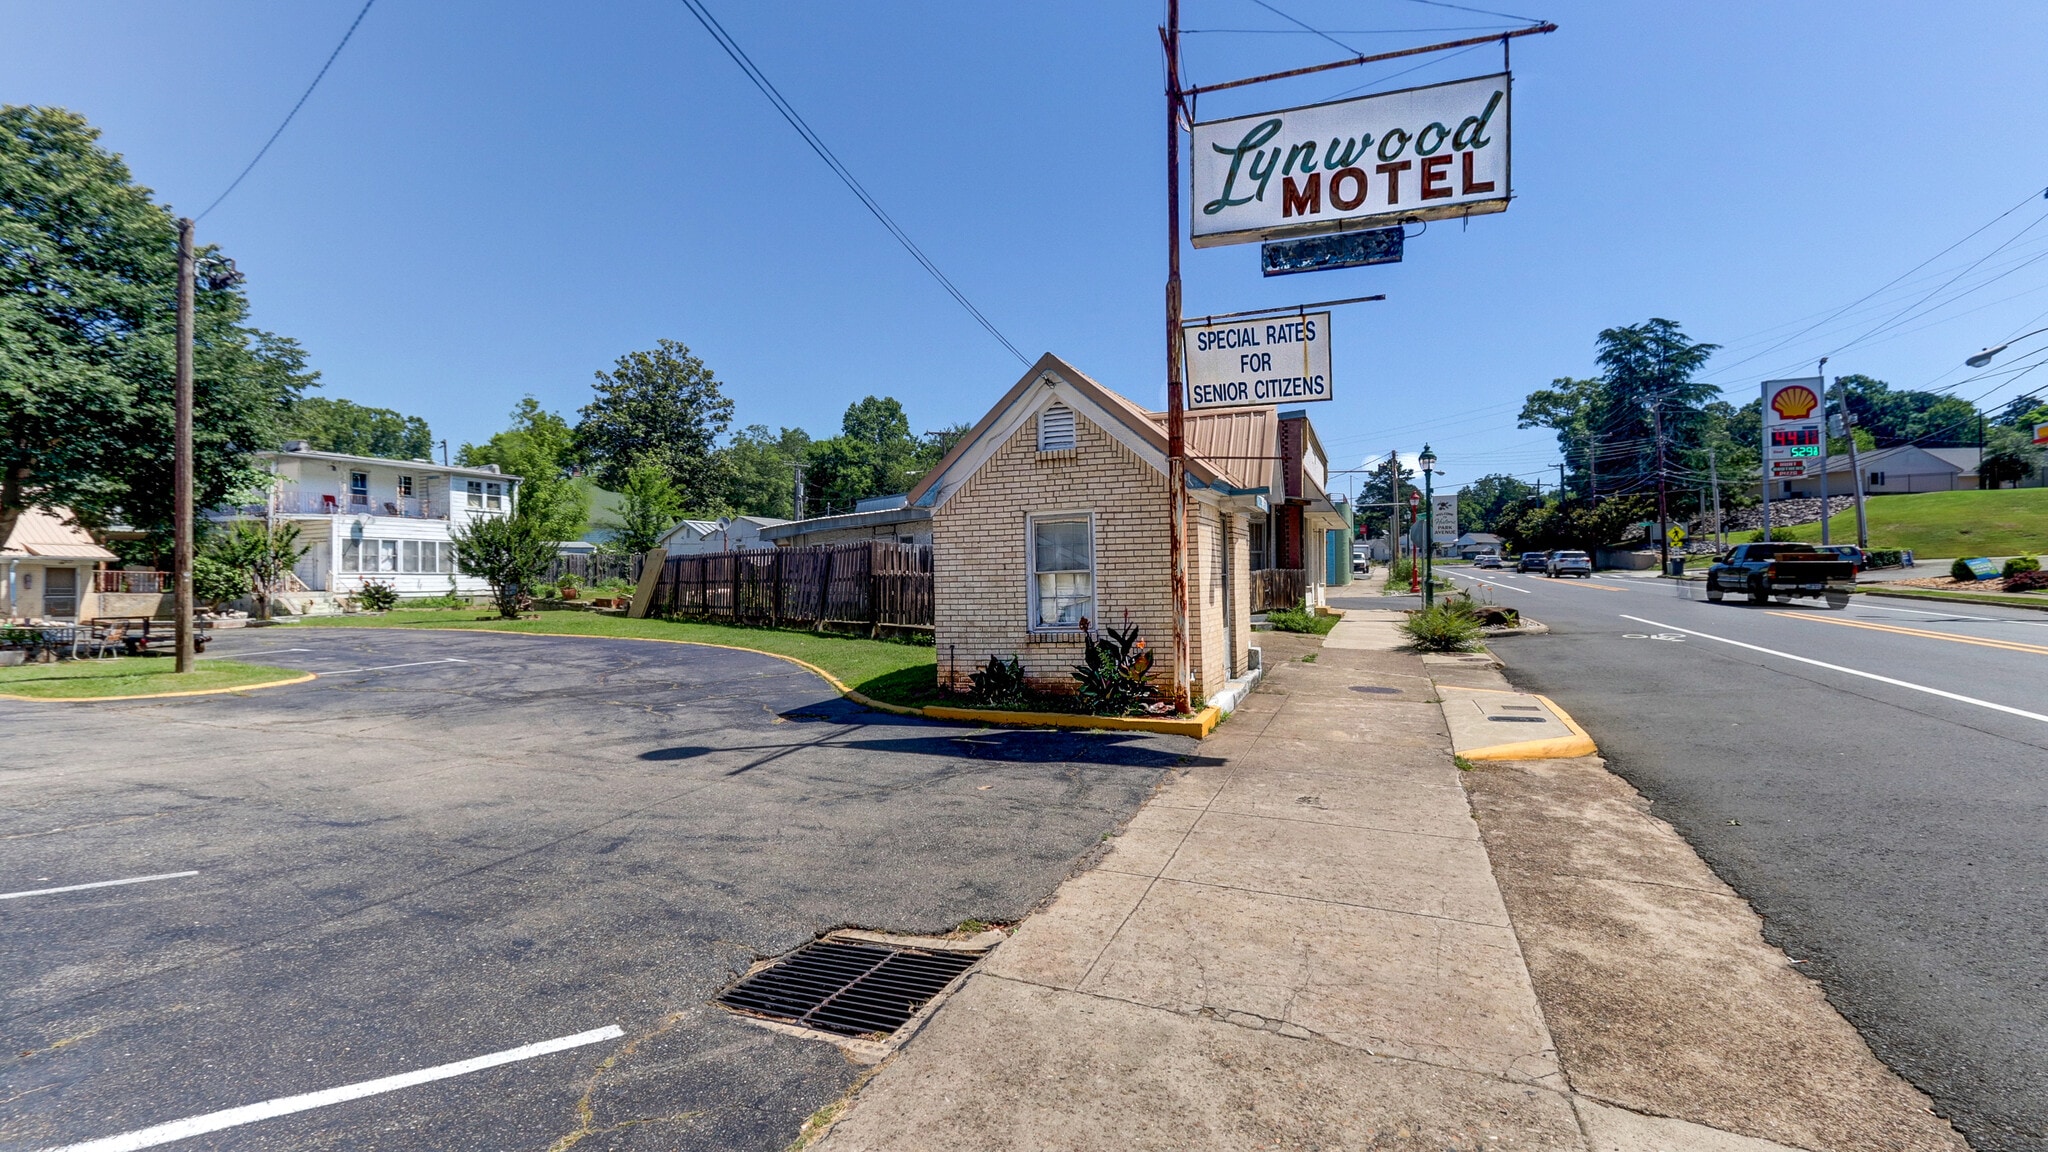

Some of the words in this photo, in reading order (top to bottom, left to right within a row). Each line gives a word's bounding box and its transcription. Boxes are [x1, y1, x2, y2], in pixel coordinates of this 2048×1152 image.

[1203, 90, 1504, 215] Lynwood
[1282, 151, 1495, 218] MOTEL
[1197, 327, 1260, 351] SPECIAL
[1266, 320, 1316, 345] RATES
[1240, 352, 1272, 373] FOR
[1193, 382, 1248, 404] SENIOR
[1254, 375, 1325, 399] CITIZENS
